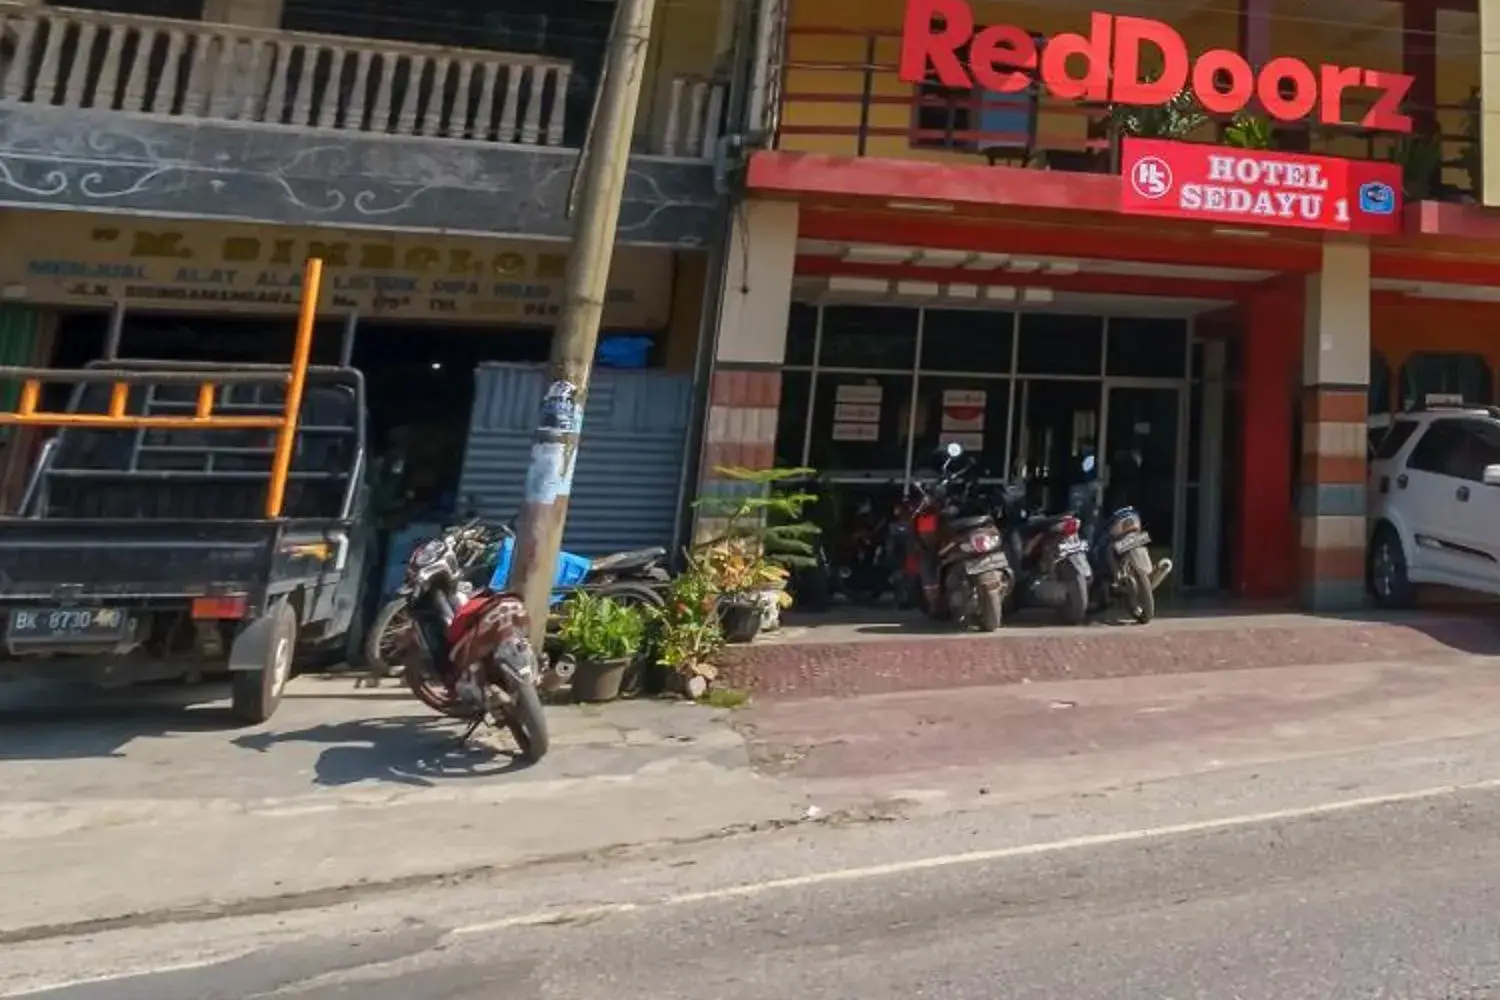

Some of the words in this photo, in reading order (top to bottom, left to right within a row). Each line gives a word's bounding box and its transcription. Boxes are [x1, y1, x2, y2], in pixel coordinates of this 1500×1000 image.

[1207, 154, 1329, 190] HOTEL
[1180, 183, 1323, 220] SEDAYU
[1333, 198, 1351, 222] 1
